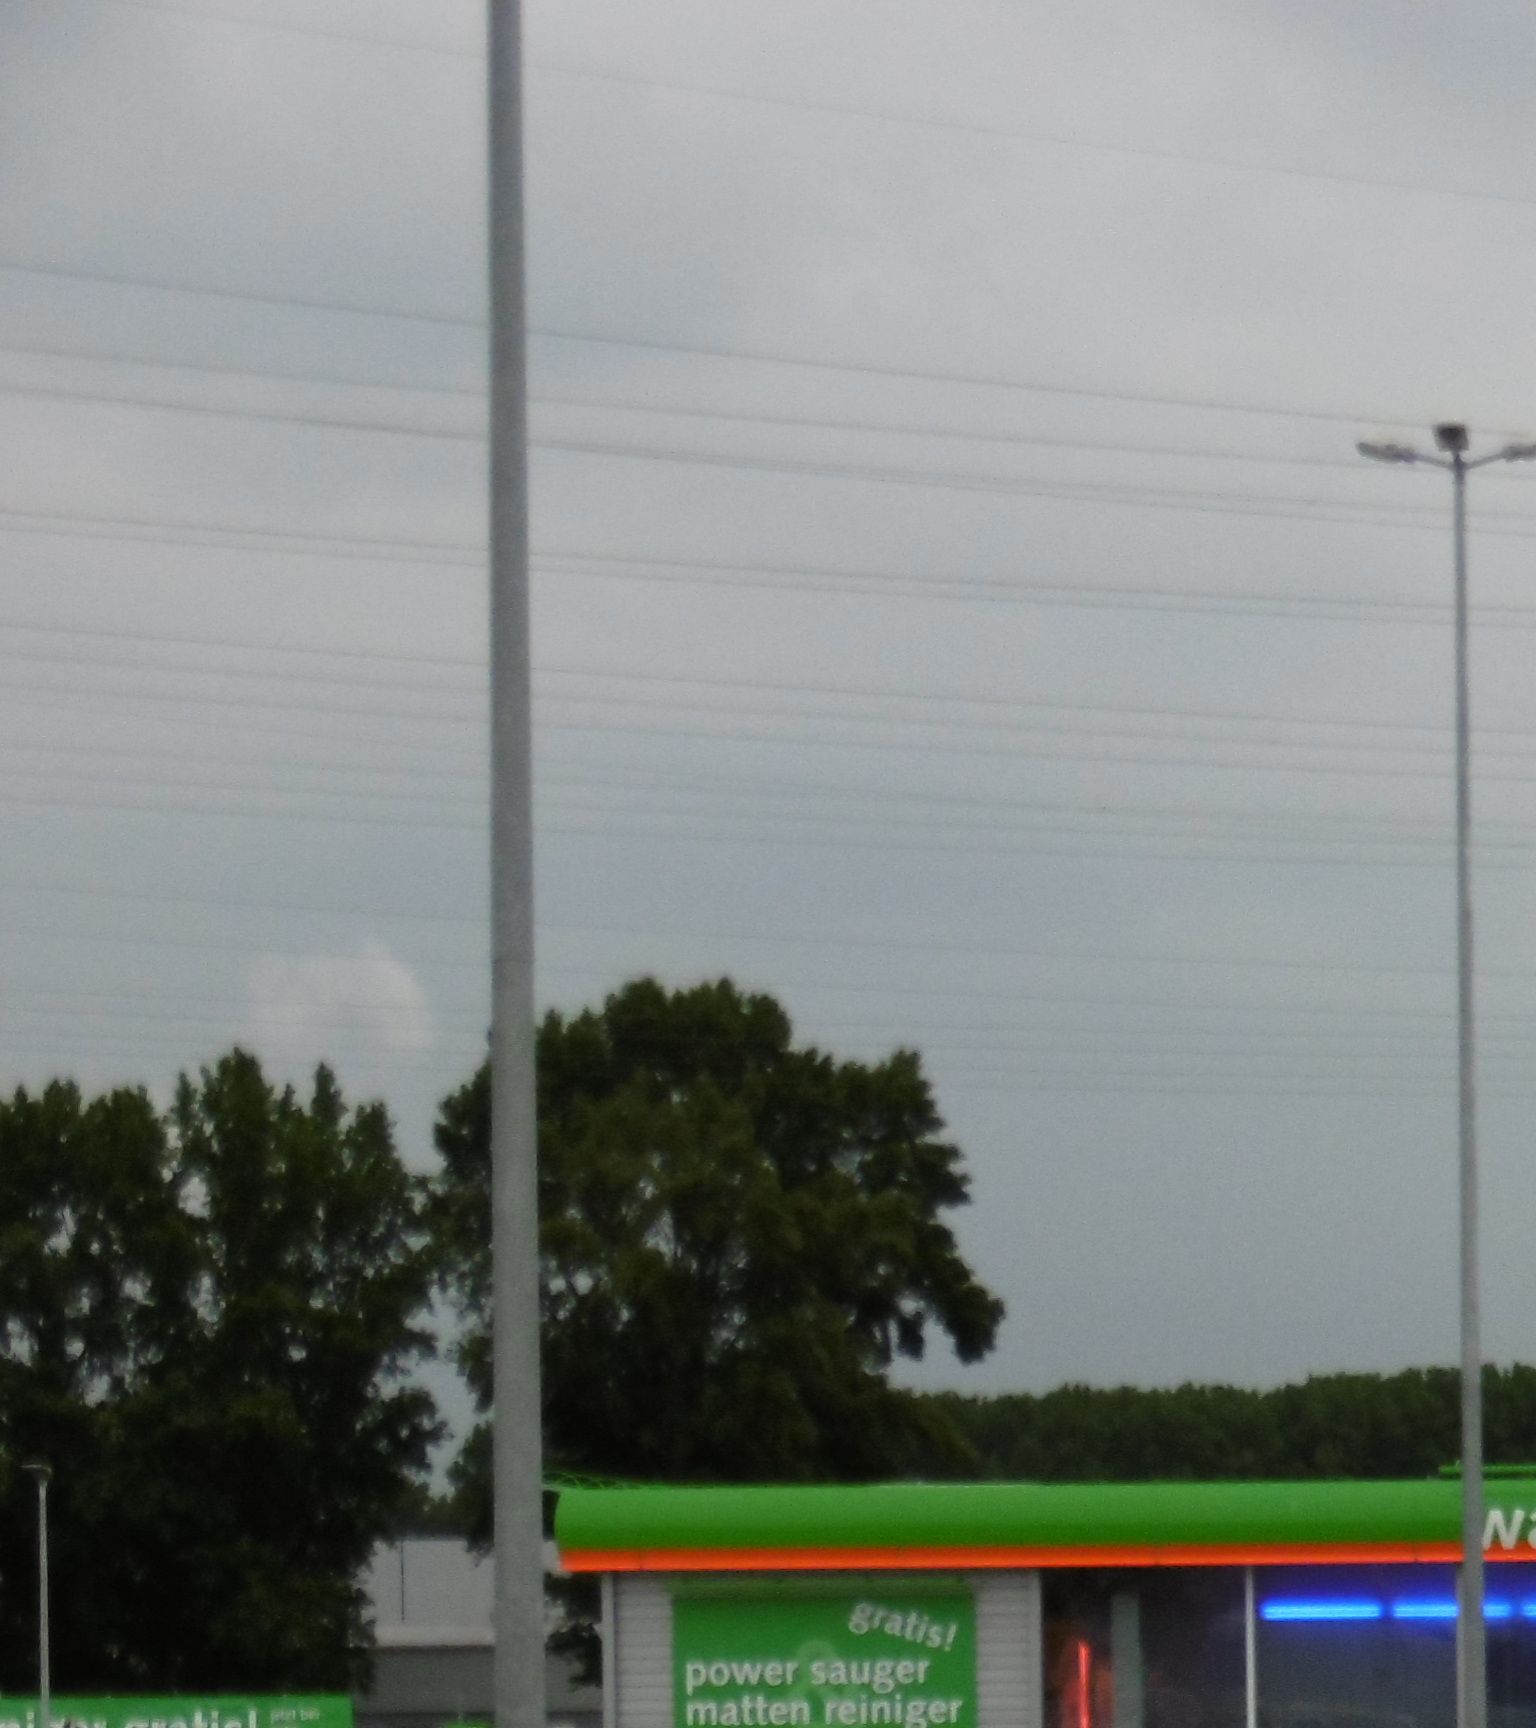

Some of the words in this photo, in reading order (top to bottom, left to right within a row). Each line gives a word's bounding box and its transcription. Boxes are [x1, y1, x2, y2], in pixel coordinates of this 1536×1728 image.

[848, 1602, 958, 1651] gratis!
[686, 1658, 799, 1696] power
[810, 1658, 930, 1694] sauger
[686, 1695, 811, 1727] matten
